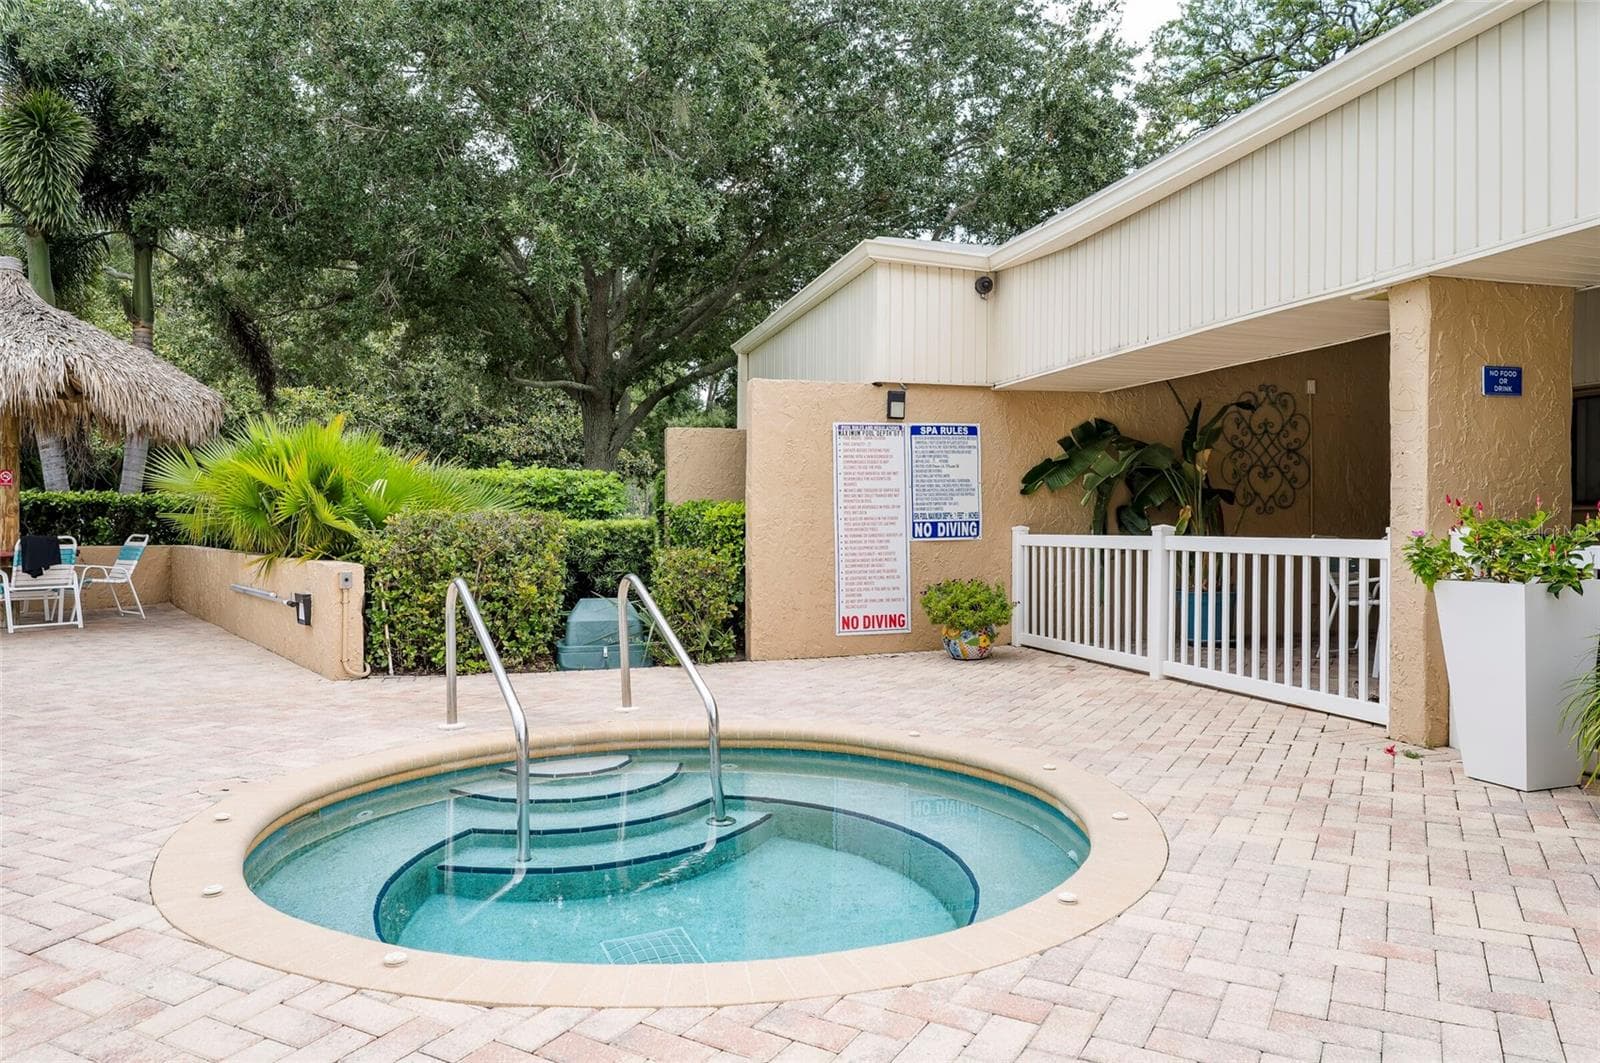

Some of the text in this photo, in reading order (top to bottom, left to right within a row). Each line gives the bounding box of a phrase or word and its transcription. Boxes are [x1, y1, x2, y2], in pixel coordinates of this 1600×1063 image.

[1500, 370, 1517, 378] FOOD
[1498, 377, 1508, 385] OR
[1493, 385, 1513, 393] DRINK
[920, 426, 969, 435] SPA RULES
[914, 522, 932, 537] NO
[937, 521, 978, 537] DIVING
[842, 613, 906, 630] NO DIVING
